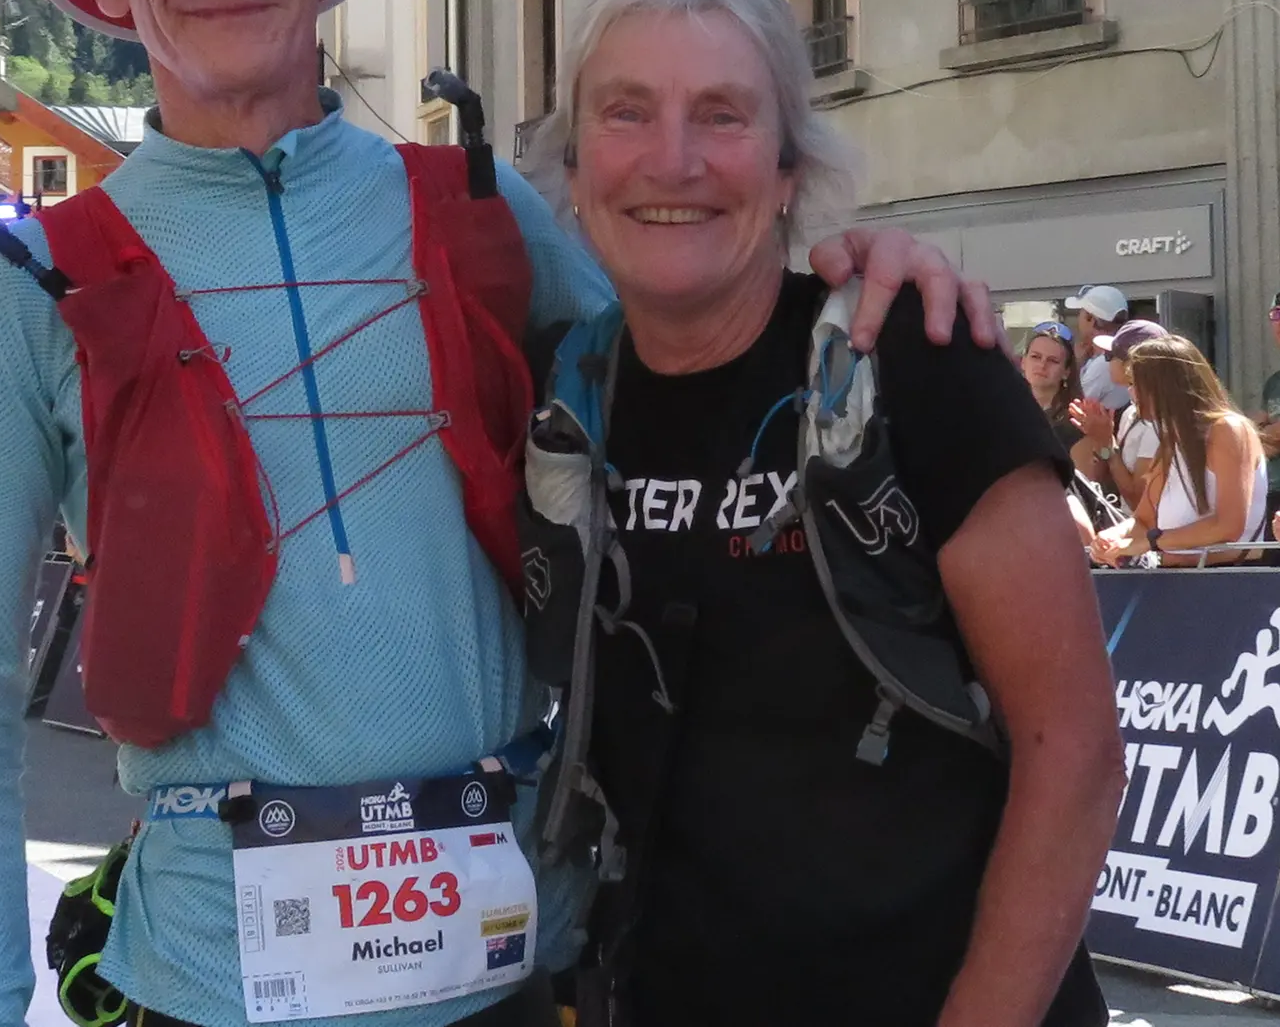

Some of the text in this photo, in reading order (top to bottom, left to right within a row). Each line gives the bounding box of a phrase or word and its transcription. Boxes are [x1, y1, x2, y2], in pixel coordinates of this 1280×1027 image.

[1116, 236, 1172, 256] CRAFT
[1116, 680, 1203, 734] HOKA
[153, 784, 227, 817] HOK
[360, 795, 386, 805] HOKA
[360, 802, 413, 822] UTMB
[346, 837, 439, 870] UTMB
[332, 872, 461, 929] 1263
[352, 929, 443, 962] Michael
[377, 961, 423, 975] SULLIVAN
